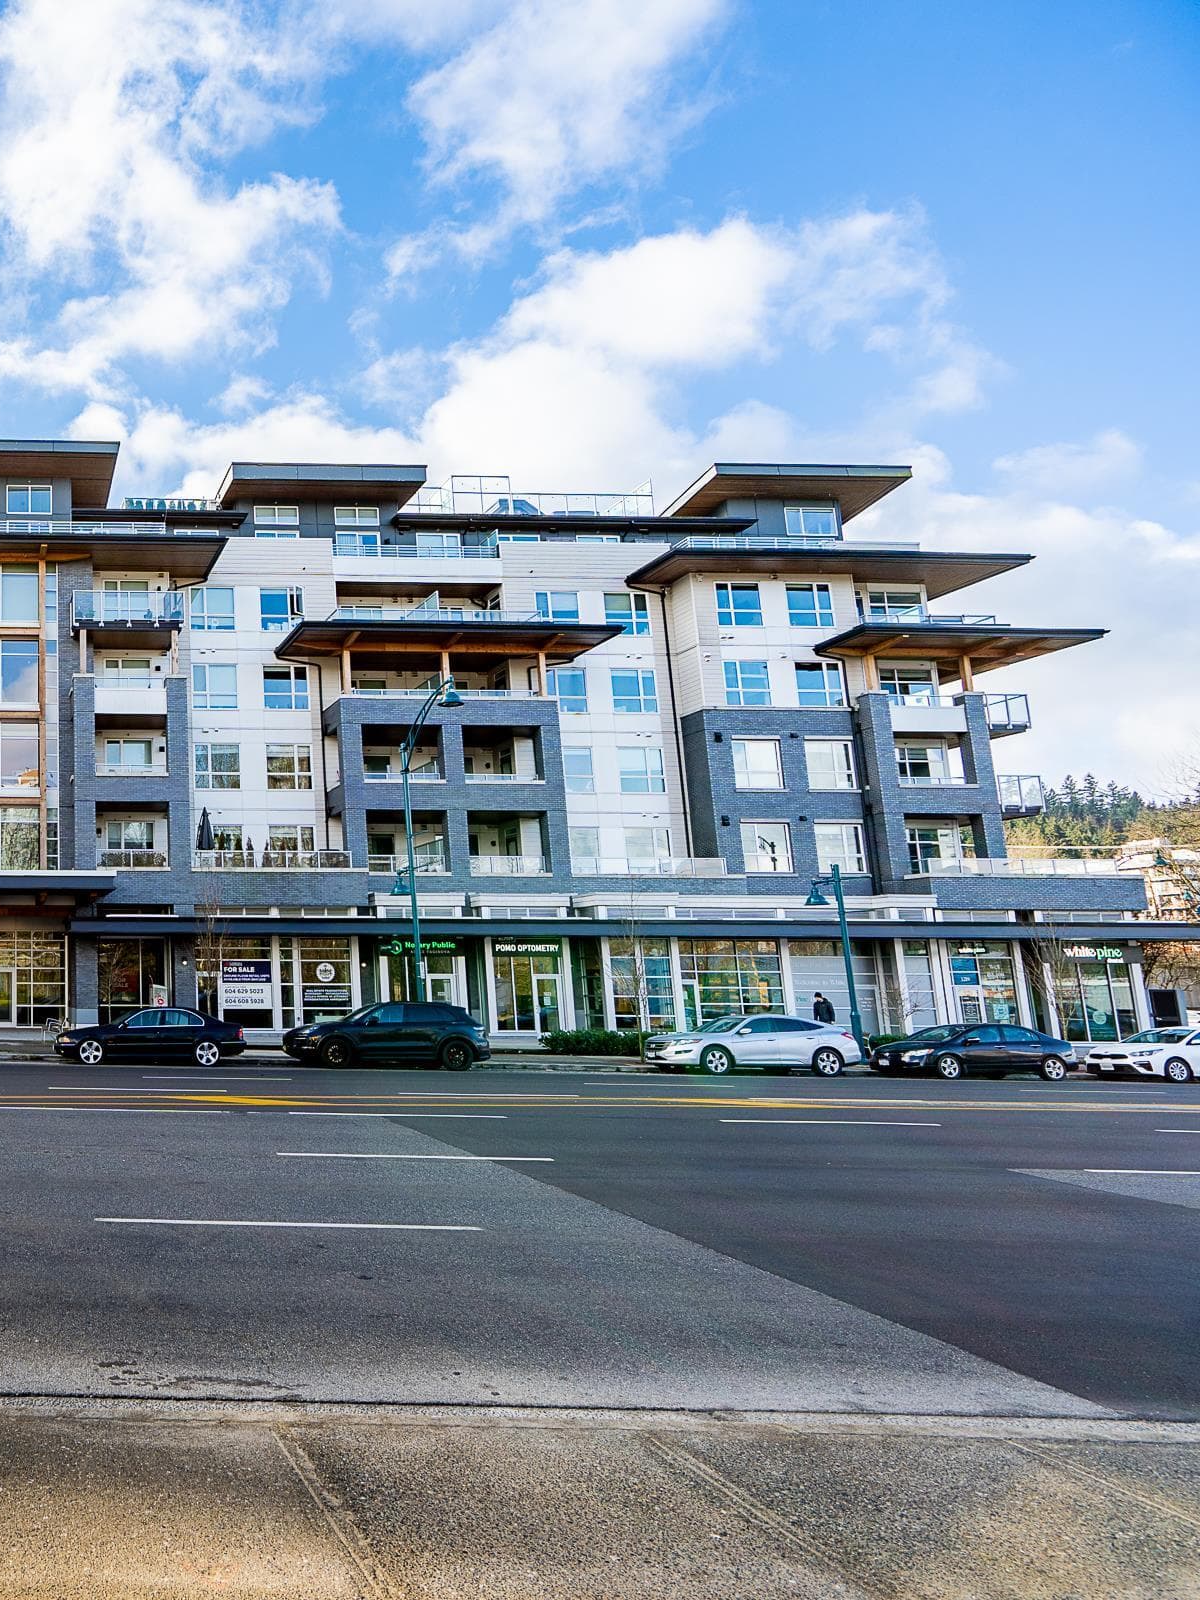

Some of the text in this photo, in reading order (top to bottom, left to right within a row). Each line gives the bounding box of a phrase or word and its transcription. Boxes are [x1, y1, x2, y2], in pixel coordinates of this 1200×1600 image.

[405, 941, 431, 949] Noary
[495, 944, 559, 952] POMO OPTOMETRY
[1062, 945, 1123, 960] white pine
